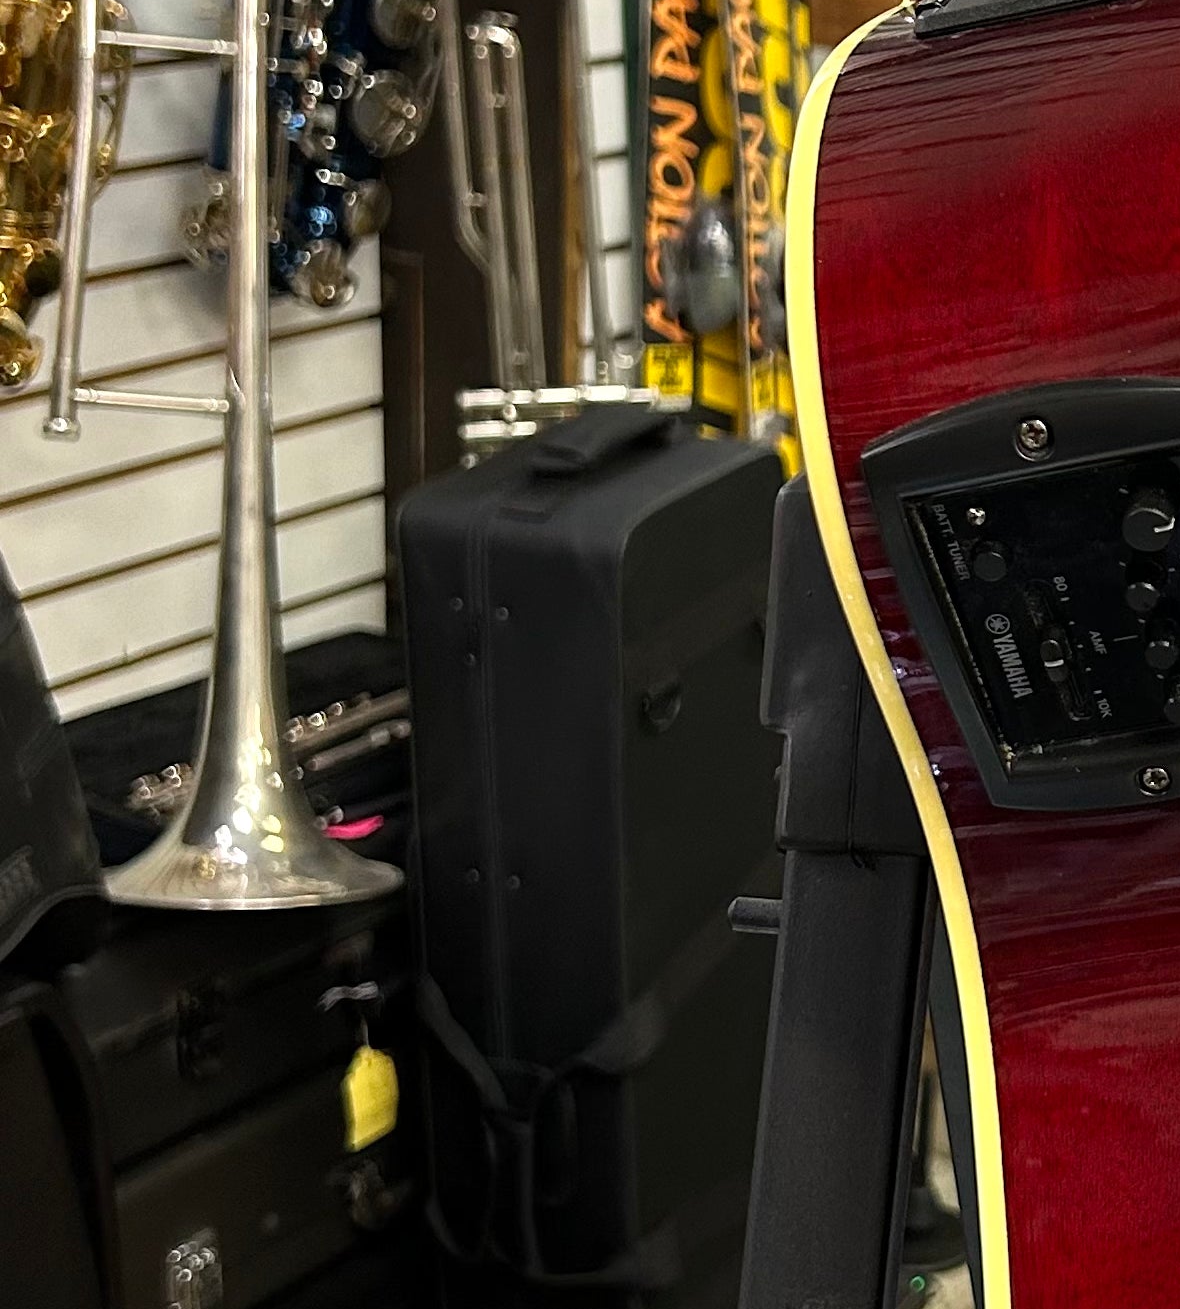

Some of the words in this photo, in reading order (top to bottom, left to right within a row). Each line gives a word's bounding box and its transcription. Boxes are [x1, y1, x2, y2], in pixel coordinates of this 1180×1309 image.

[947, 540, 970, 580] TUNER
[1053, 576, 1068, 591] 80
[1089, 630, 1107, 654] AMF
[993, 633, 1034, 698] YAMAHA
[1097, 698, 1112, 718] 10K
